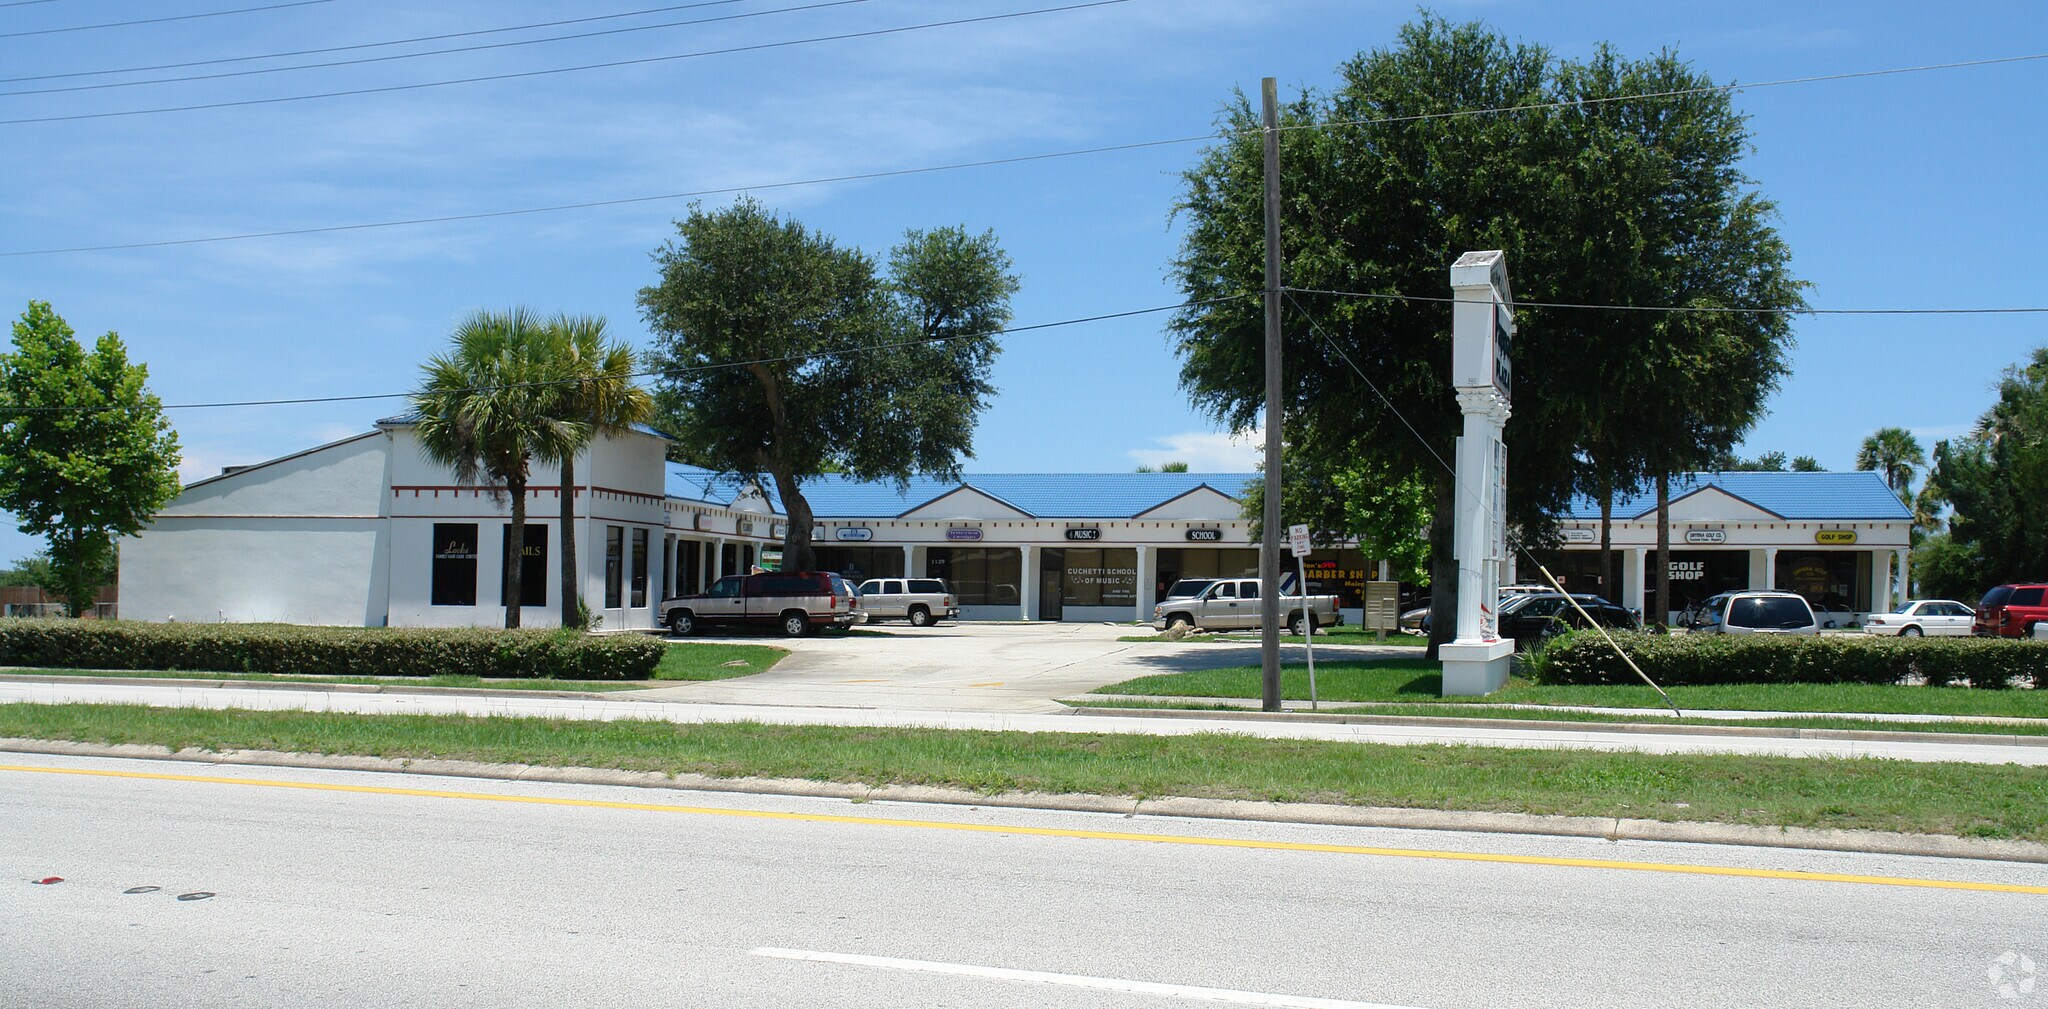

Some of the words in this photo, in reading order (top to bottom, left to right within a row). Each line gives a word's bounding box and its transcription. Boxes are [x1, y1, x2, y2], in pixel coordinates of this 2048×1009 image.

[1074, 530, 1092, 538] MUSIC
[1192, 531, 1216, 540] SCHOOL
[1669, 562, 1704, 570] GOLF
[1669, 571, 1704, 580] SHOP
